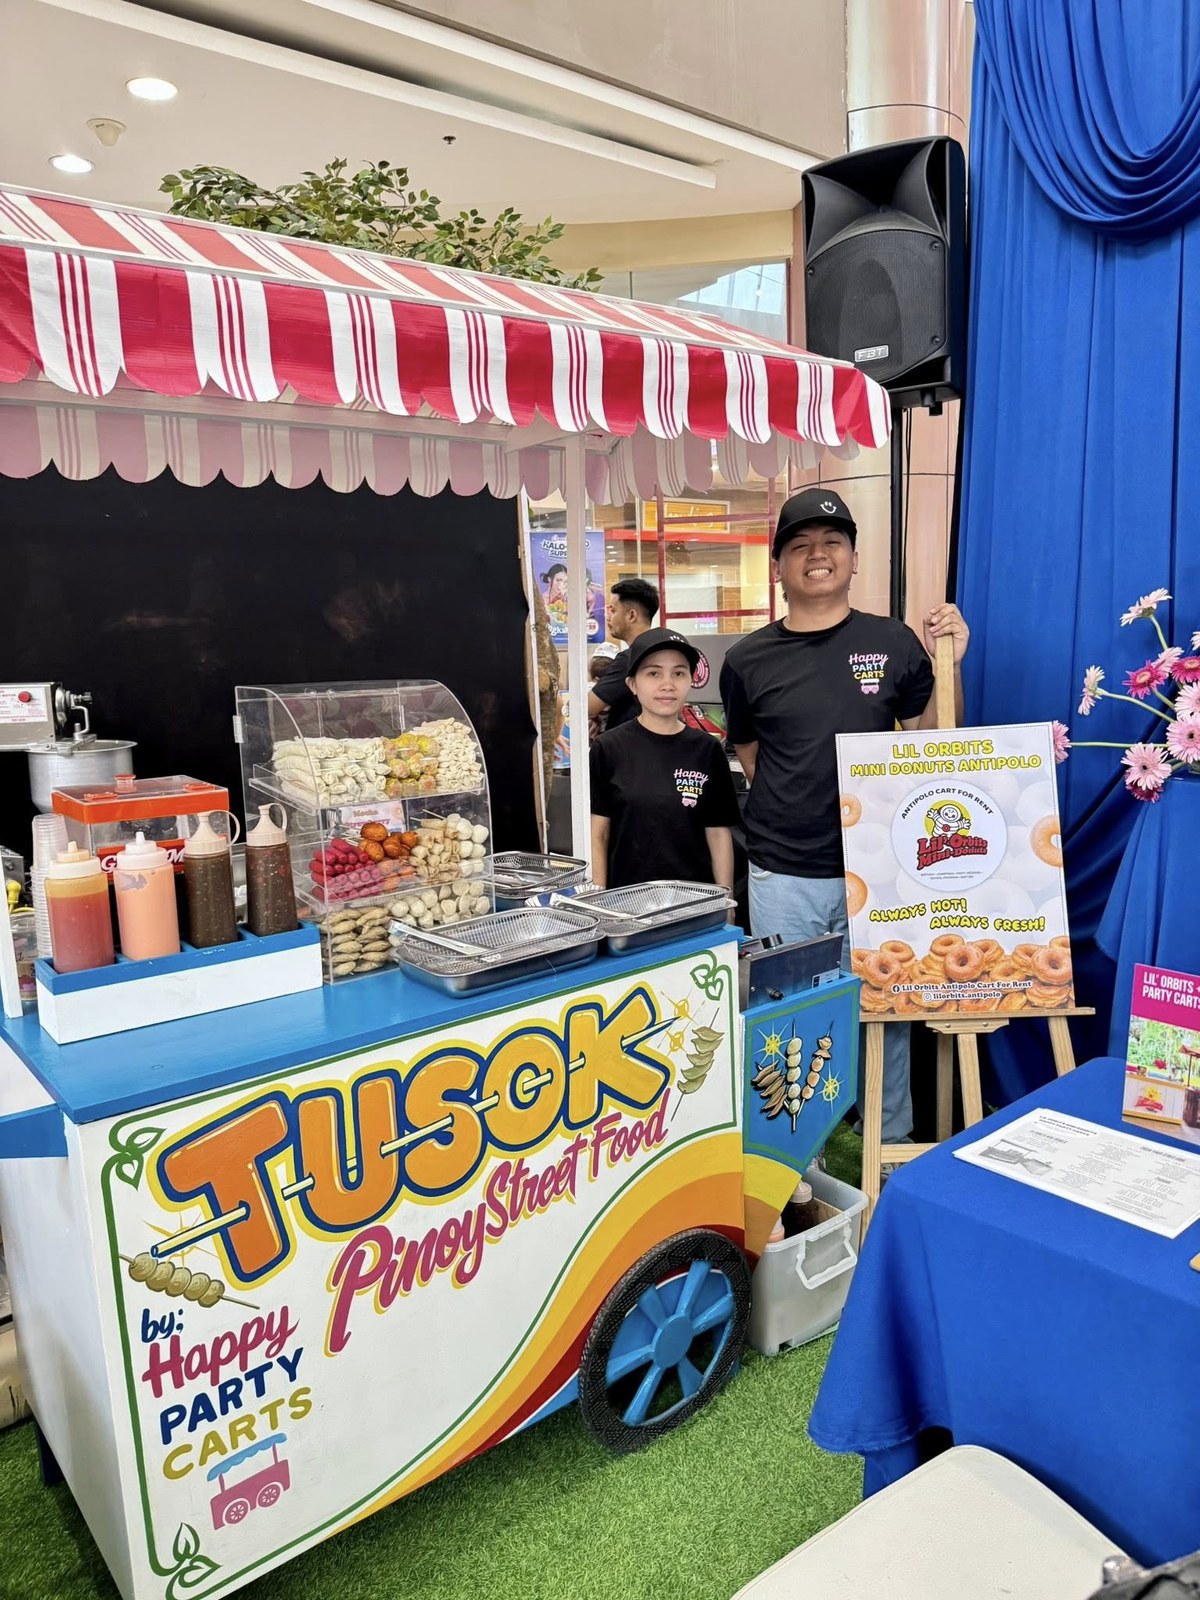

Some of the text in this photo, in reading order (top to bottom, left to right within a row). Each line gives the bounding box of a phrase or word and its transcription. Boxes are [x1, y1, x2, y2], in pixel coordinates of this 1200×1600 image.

[858, 347, 886, 360] FBT
[848, 653, 889, 665] Happy
[852, 663, 885, 672] PARTY
[854, 670, 885, 679] CARTS
[892, 739, 994, 759] LIL ORBITS
[851, 755, 1042, 777] MINI DONUTS ANTIPOLO
[673, 768, 709, 783] Happy
[676, 778, 706, 788] PARTY
[676, 786, 704, 795] CARTS
[901, 790, 935, 819] ANTIPOLO
[957, 789, 974, 799] FOR
[974, 797, 994, 815] RENT
[948, 833, 988, 849] Orbits
[869, 898, 968, 922] ALWAYS HOT!
[929, 915, 1046, 932] ALWAYS FRESH!
[914, 983, 939, 991] Orbits
[940, 982, 976, 991] Antipolo
[977, 981, 995, 989] Cart
[1012, 980, 1032, 988] Rent
[1143, 971, 1195, 994] LIL' ORBITS
[933, 991, 1001, 1000] lilorbits.antipolo
[1142, 985, 1173, 1003] PARTY
[157, 986, 672, 1284] TUSOK
[327, 1088, 671, 1357] Pinoy Street Food
[141, 1305, 301, 1398] Happy
[159, 1347, 304, 1445] PARTY
[162, 1387, 313, 1480] CARTS
